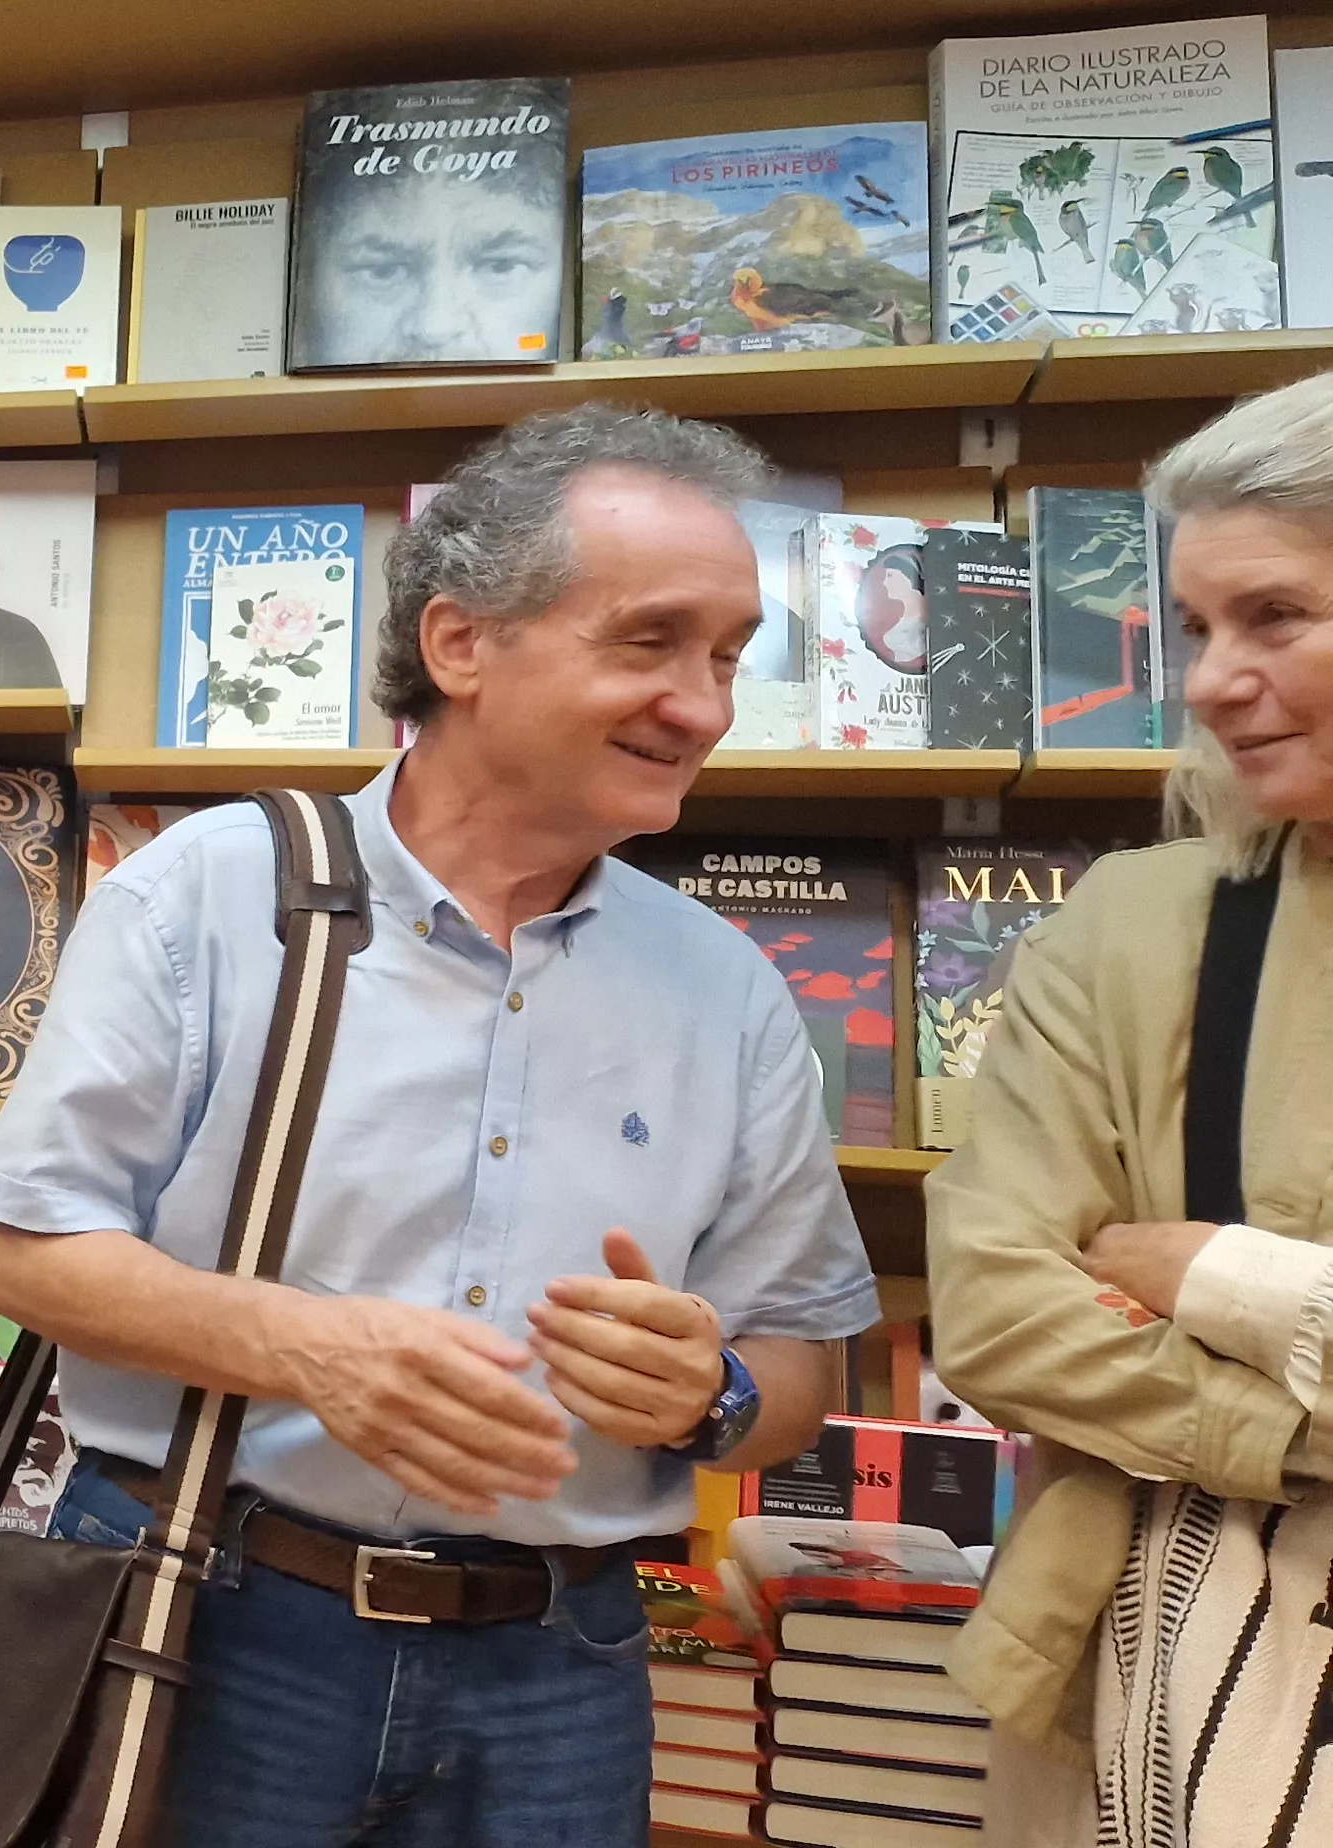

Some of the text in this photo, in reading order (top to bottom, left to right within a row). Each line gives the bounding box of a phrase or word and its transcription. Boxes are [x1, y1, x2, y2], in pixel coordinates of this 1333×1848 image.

[982, 39, 1226, 78] DIARIO ILUSTRADO
[979, 62, 1231, 99] DE LA NATURALEZA
[1030, 100, 1047, 112] DE
[1159, 90, 1167, 100] Y
[1173, 86, 1223, 100] DIBUJO
[325, 105, 551, 146] Trasmundo
[353, 143, 518, 183] de Goya
[670, 157, 840, 185] LOS PIRINEOS
[174, 203, 275, 223] BILLIE HOLIDAY
[187, 519, 349, 552] UN AÑO
[50, 539, 62, 608] ANTONIO SANTOS
[957, 562, 1018, 577] MITOLOGÍA
[957, 574, 1014, 586] EN EL ARTE
[301, 702, 342, 715] El amor
[863, 714, 880, 729] Lady
[702, 853, 822, 877] CAMPOS
[998, 847, 1045, 861] Hesse
[678, 876, 848, 902] DE CASTILLA
[762, 906, 813, 916] MACHADO
[763, 1499, 845, 1516] IRENE VALLEJO
